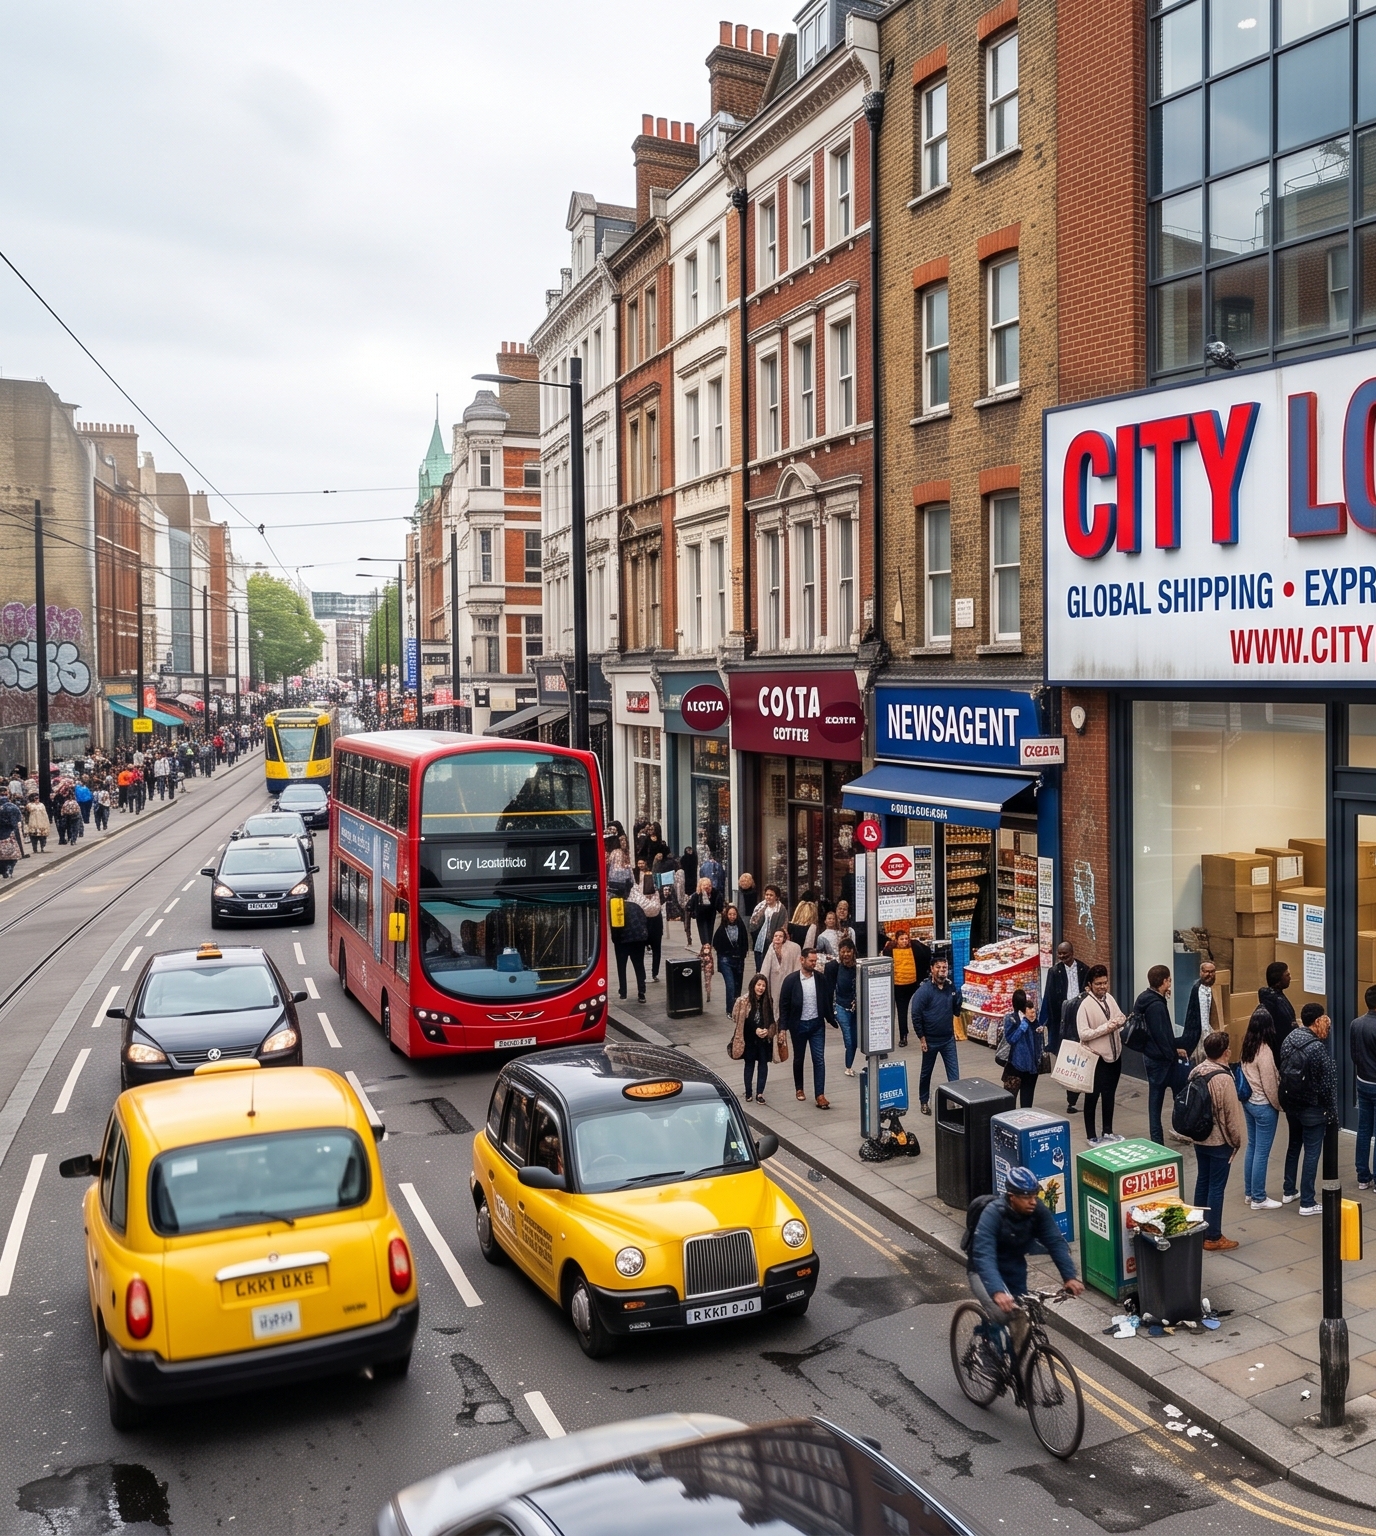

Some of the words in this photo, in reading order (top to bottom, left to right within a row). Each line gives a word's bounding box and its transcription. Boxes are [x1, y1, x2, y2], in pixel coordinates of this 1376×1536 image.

[1063, 401, 1261, 559] CITY
[1067, 583, 1152, 618] GLOBAL
[1158, 572, 1273, 613] SHIPPING
[758, 686, 821, 721] COSTA
[888, 704, 1020, 747] NEWSAGENT
[447, 858, 472, 871] City
[543, 850, 570, 870] 42
